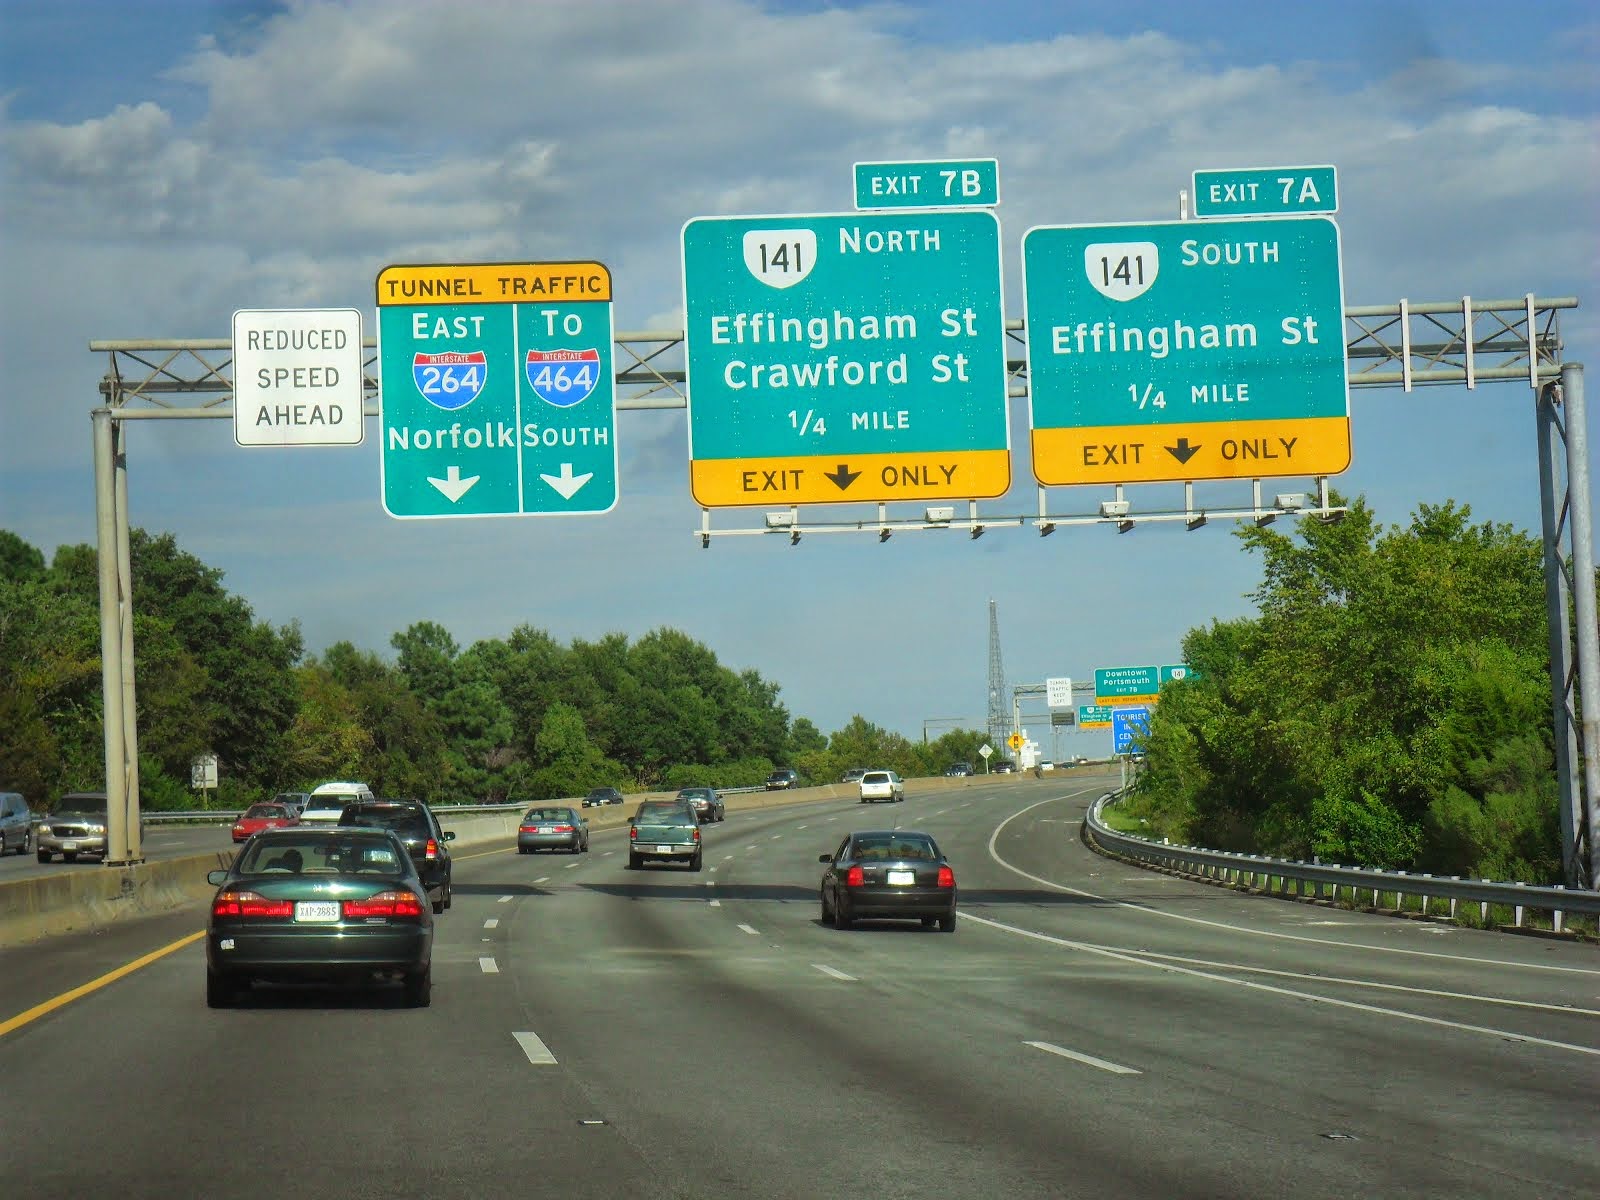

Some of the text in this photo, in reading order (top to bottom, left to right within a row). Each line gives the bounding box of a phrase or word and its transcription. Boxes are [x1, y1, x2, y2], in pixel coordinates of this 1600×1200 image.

[871, 170, 982, 197] EXIT 7B
[1209, 177, 1321, 204] EXIT 7A
[759, 227, 941, 274] 141 NORTH
[1101, 239, 1280, 286] 141 SOUTH
[386, 275, 602, 298] TUNNEL TRAFFIC
[412, 312, 485, 339] EAST
[711, 308, 977, 350] Effingham St
[1052, 316, 1319, 358] Effingham St
[247, 329, 347, 351] REDUCED
[429, 354, 470, 364] INTERSTATE
[542, 351, 583, 361] INTERSTATE
[257, 367, 339, 389] SPEED
[422, 367, 480, 394] 264
[534, 365, 593, 392] 464
[724, 353, 969, 389] Crawford St
[1128, 383, 1250, 409] 1/4 MILE
[256, 404, 343, 427] AHEAD
[788, 409, 910, 436] 1/4 MILE
[388, 422, 515, 451] Norfolk
[523, 423, 609, 447] SOUTH
[1083, 437, 1299, 466] EXIT ONLY
[742, 464, 958, 492] EXIT ONLY
[1103, 677, 1150, 686] Portsmouth
[1105, 670, 1147, 678] Downtown
